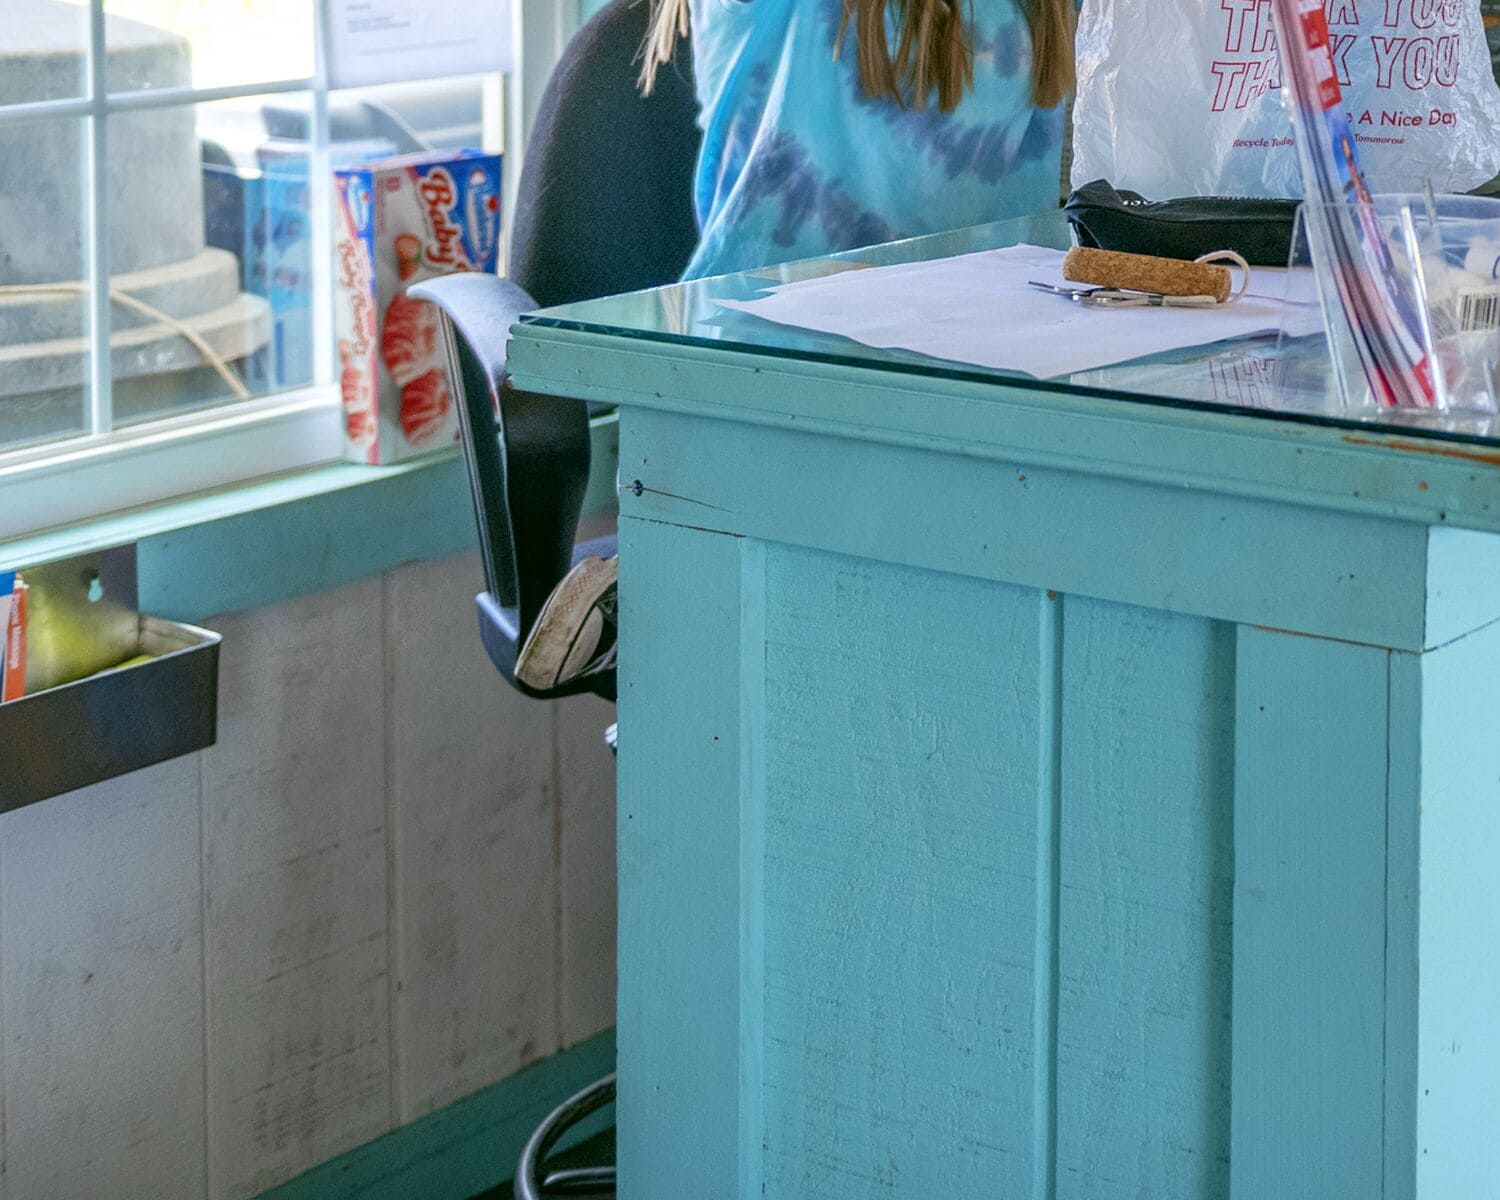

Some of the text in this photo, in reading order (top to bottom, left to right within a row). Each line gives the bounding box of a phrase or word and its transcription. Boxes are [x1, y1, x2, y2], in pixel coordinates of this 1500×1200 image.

[1371, 34, 1460, 91] YOU
[1357, 110, 1373, 125] A
[1380, 110, 1422, 127] Nice
[1232, 137, 1269, 148] Recycle
[419, 170, 459, 264] Baby
